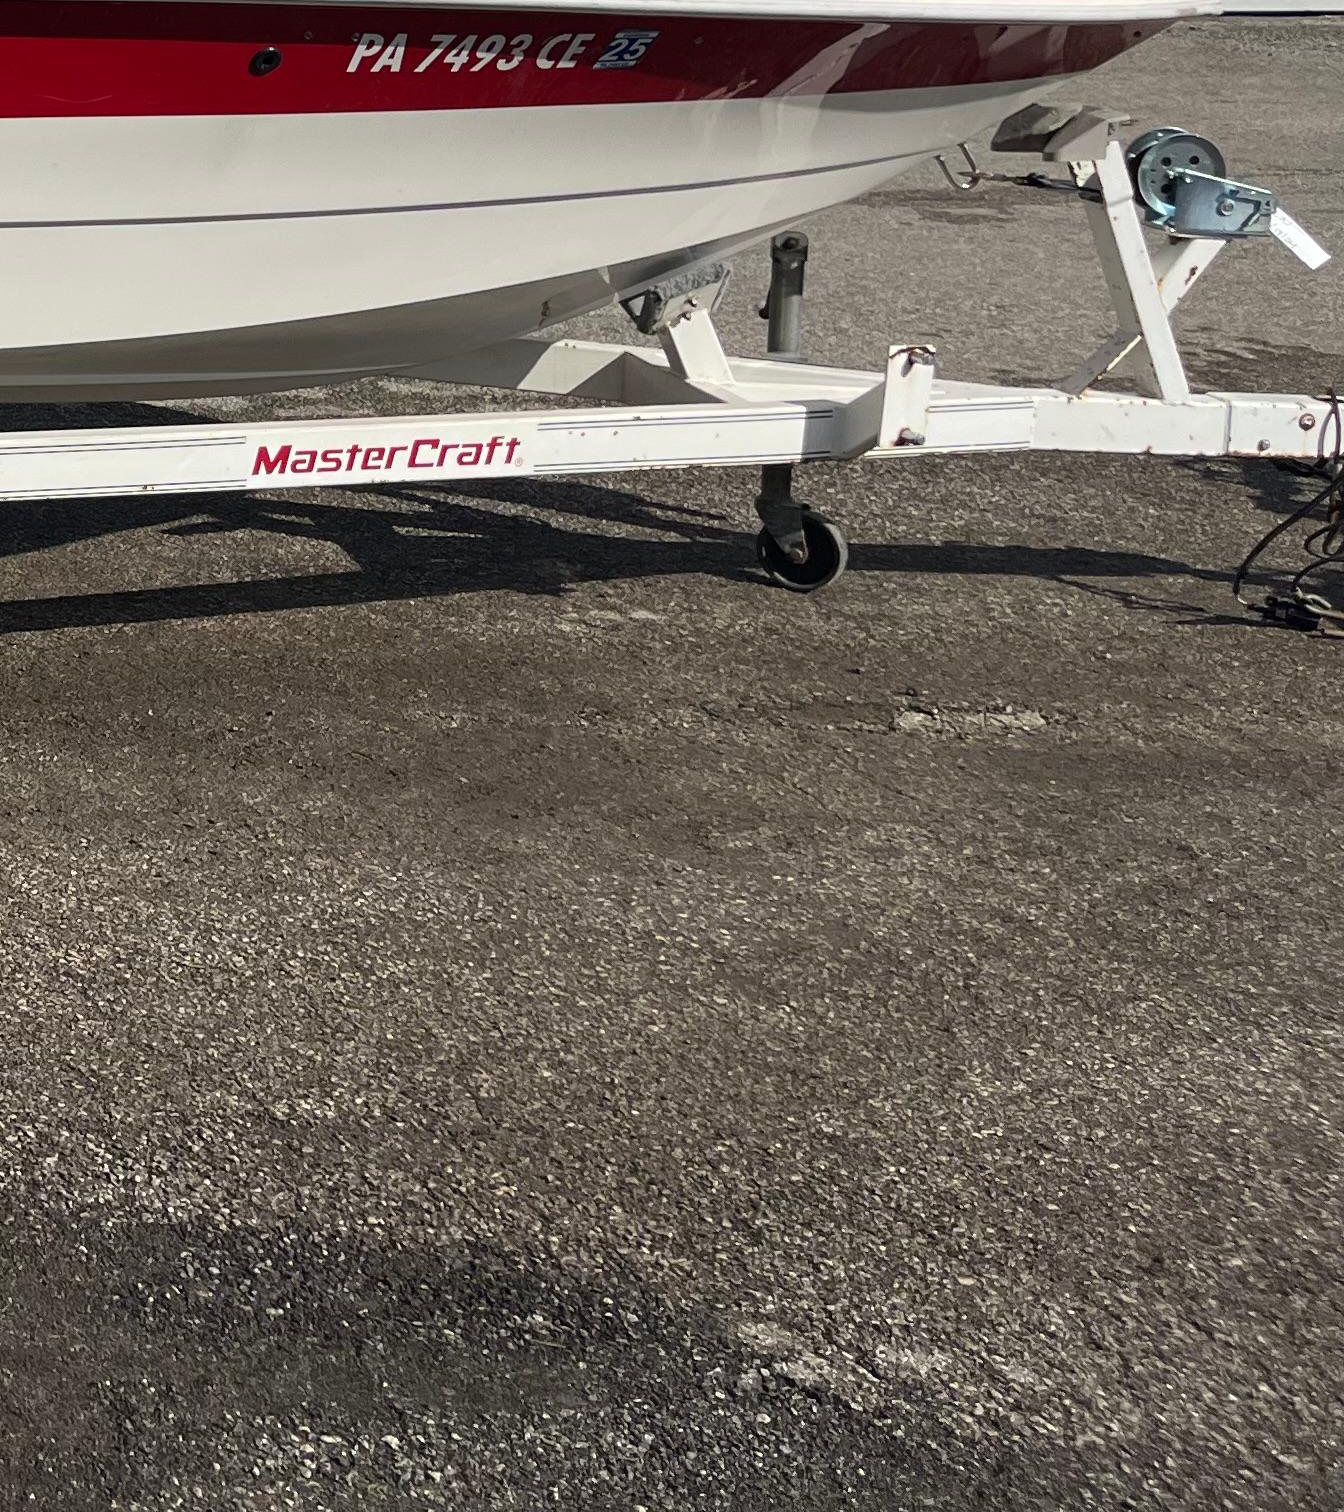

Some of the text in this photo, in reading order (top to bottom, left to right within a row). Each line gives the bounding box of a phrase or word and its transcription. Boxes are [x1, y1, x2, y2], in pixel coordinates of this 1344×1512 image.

[346, 33, 596, 73] PA 7493 CE
[597, 38, 654, 61] 25
[251, 435, 522, 476] MasterCraft
